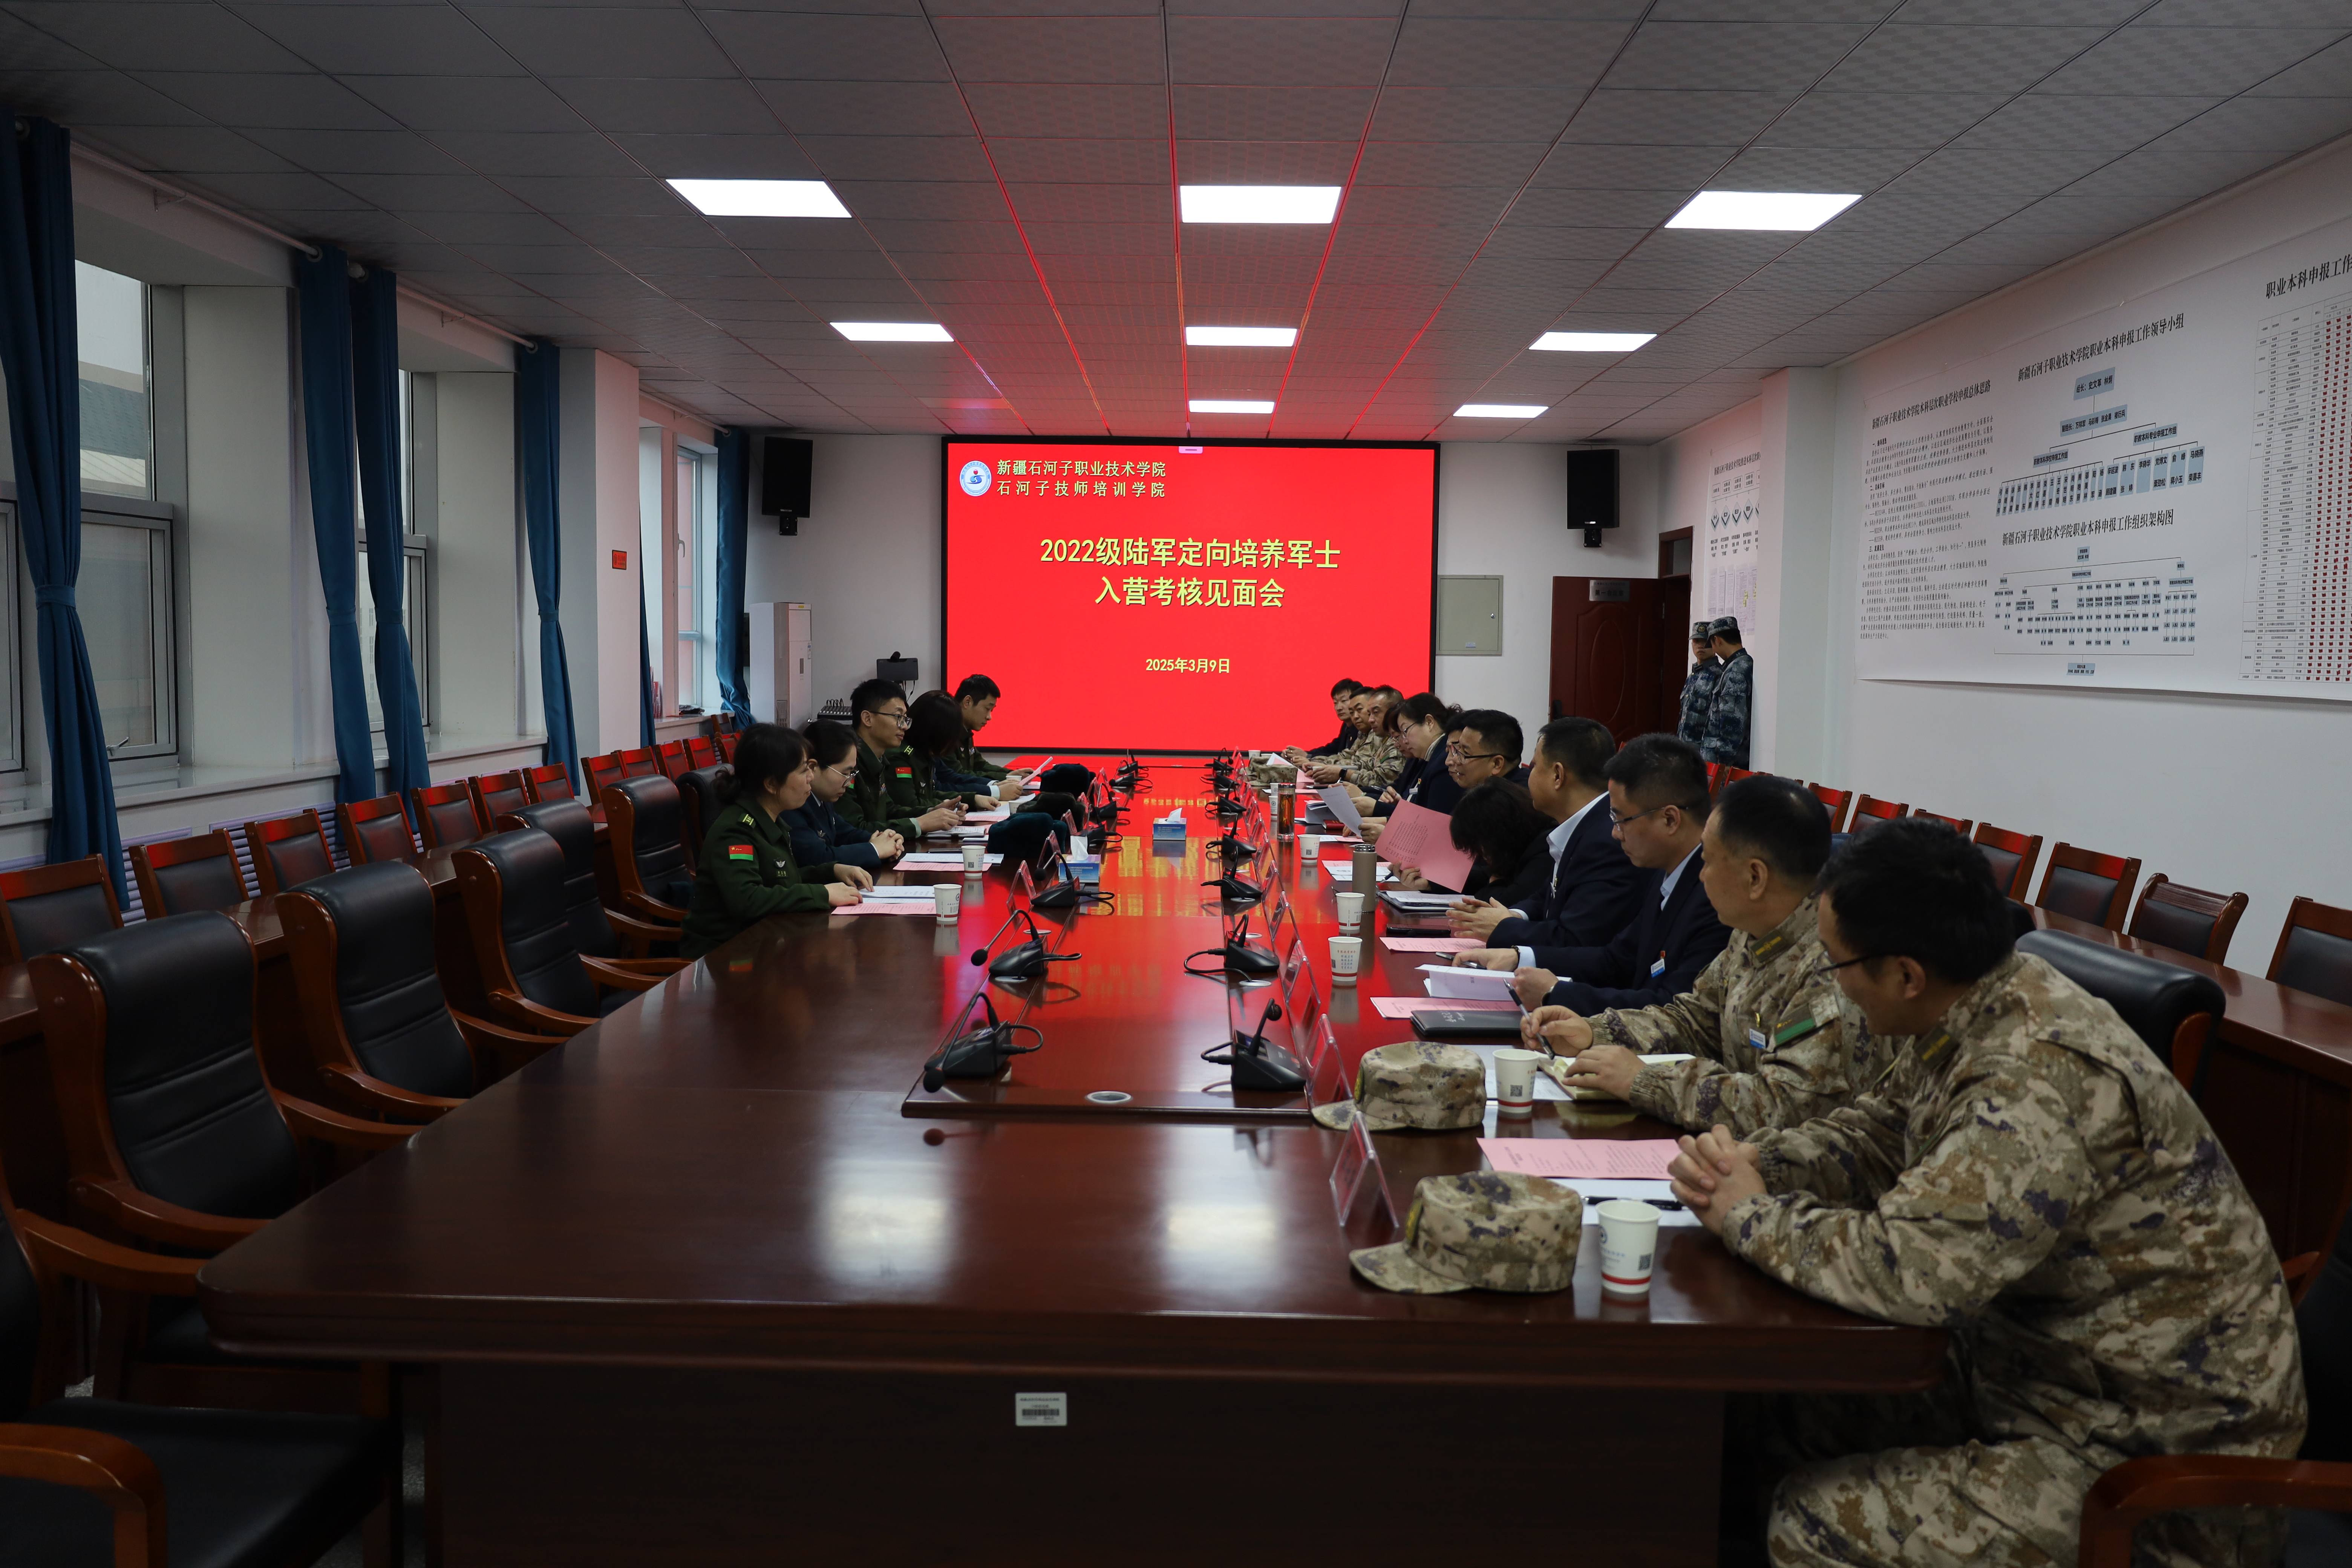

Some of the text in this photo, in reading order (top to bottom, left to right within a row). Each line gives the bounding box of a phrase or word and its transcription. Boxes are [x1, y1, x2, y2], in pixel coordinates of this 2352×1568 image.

[2018, 313, 2184, 381] 新疆石河子职业技术学院职业本科申报工作领导小组
[997, 459, 1165, 477] 新疆石河子职业技术学院
[997, 481, 1165, 497] 石河子技师培训学院
[2002, 509, 2173, 546] 新疆石河子职业技术学院职业本科申报工作组织架构图
[1041, 537, 1340, 568] 2022级陆军定向培养军士
[1095, 576, 1285, 607] 入营考核见面会
[1146, 657, 1229, 673] 2025年3月9日
